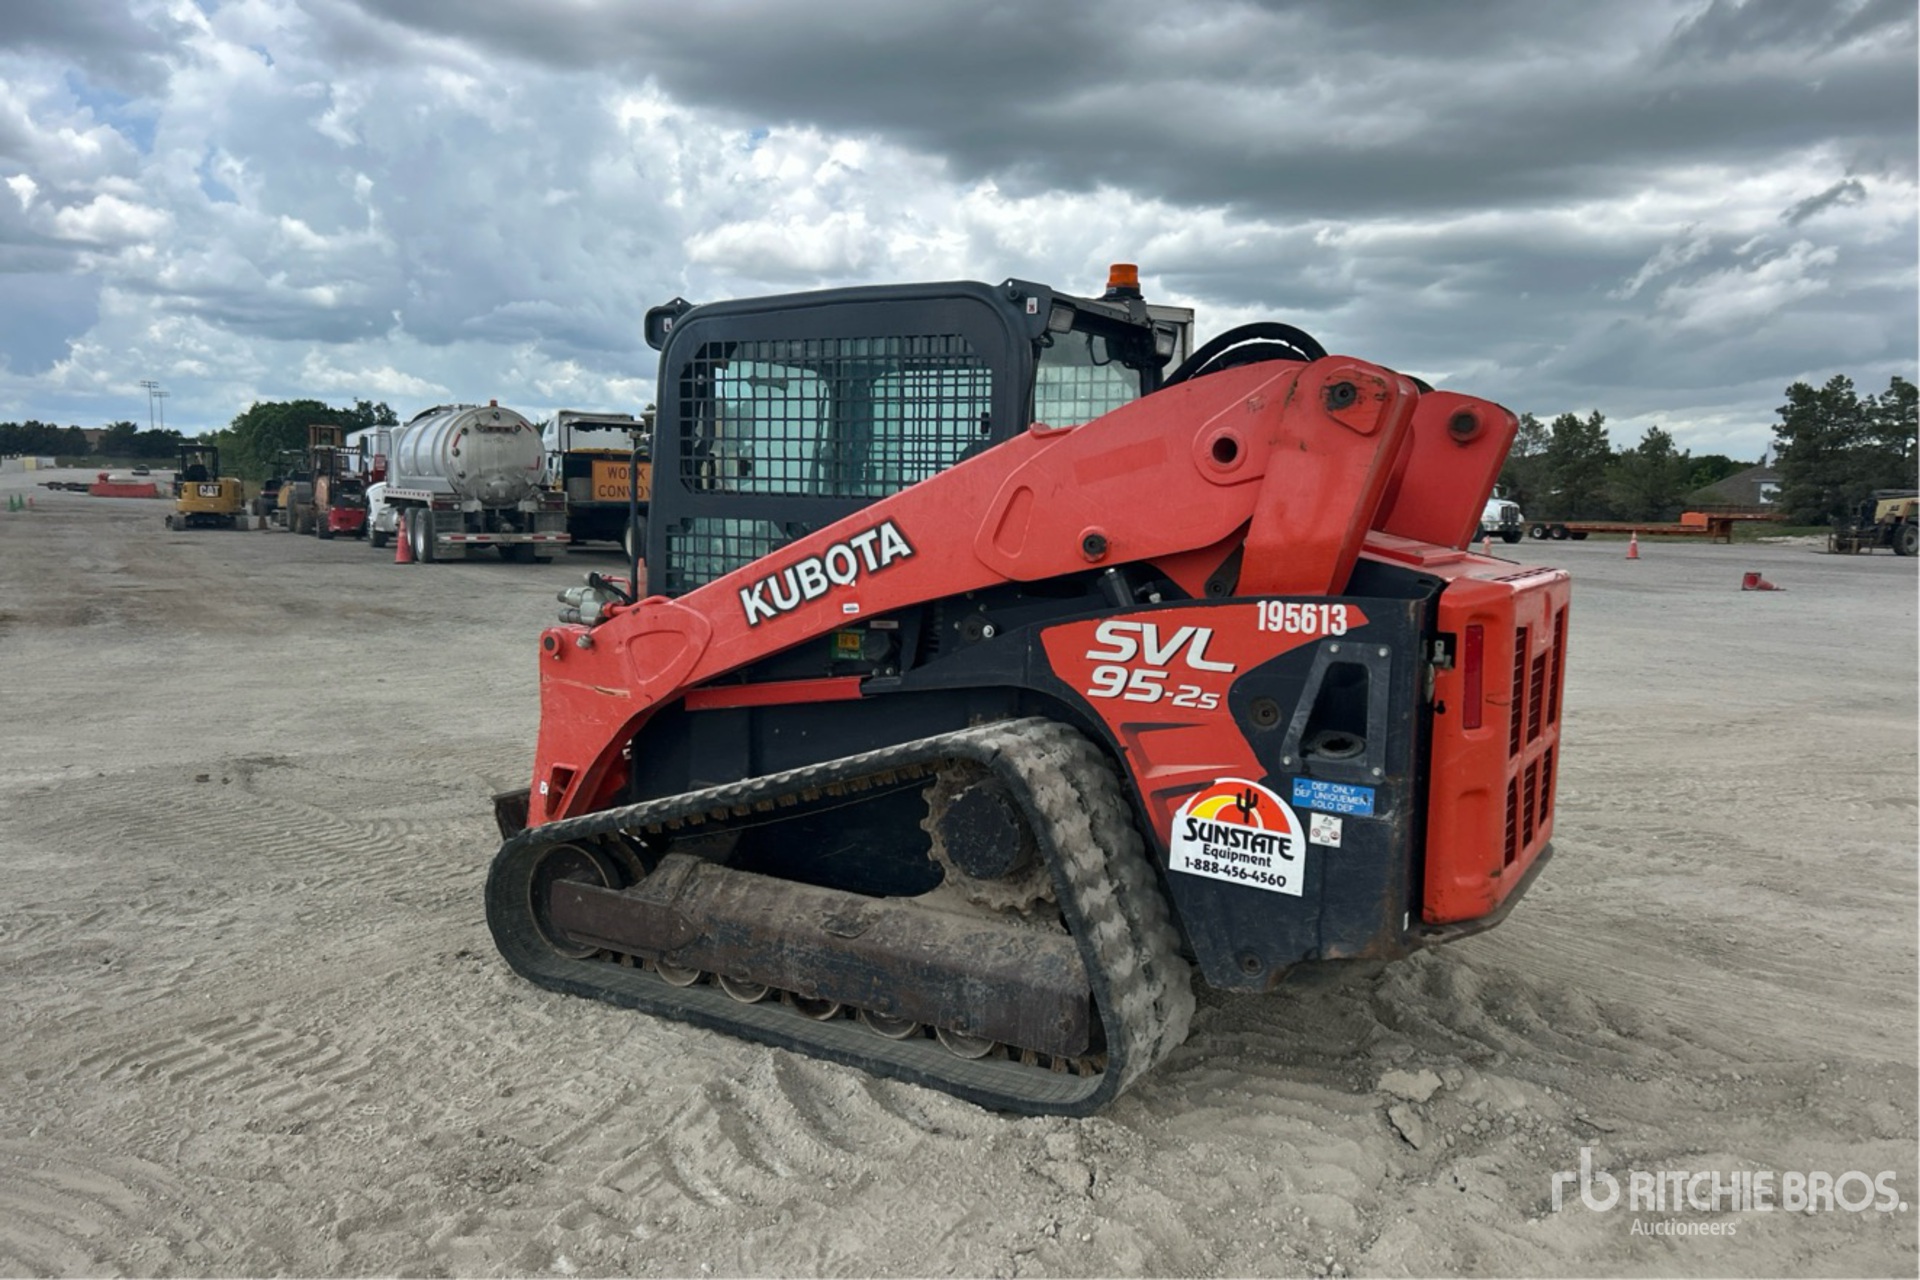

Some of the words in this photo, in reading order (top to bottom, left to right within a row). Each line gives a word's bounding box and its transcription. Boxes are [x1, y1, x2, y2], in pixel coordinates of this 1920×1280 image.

[607, 466, 646, 480] WOK
[200, 485, 220, 496] CAT
[739, 521, 912, 625] KUBOTA
[1256, 600, 1348, 636] 195613
[1085, 620, 1235, 673] SVL
[1293, 787, 1311, 797] DEF
[1311, 781, 1330, 791] DEF
[1332, 784, 1356, 795] ONLY
[1311, 799, 1335, 809] SOLO
[1336, 803, 1355, 812] DEF
[1183, 817, 1295, 861] SUNSTATE
[1203, 843, 1271, 867] Equipment
[1185, 856, 1287, 888] 1-888-456-4560
